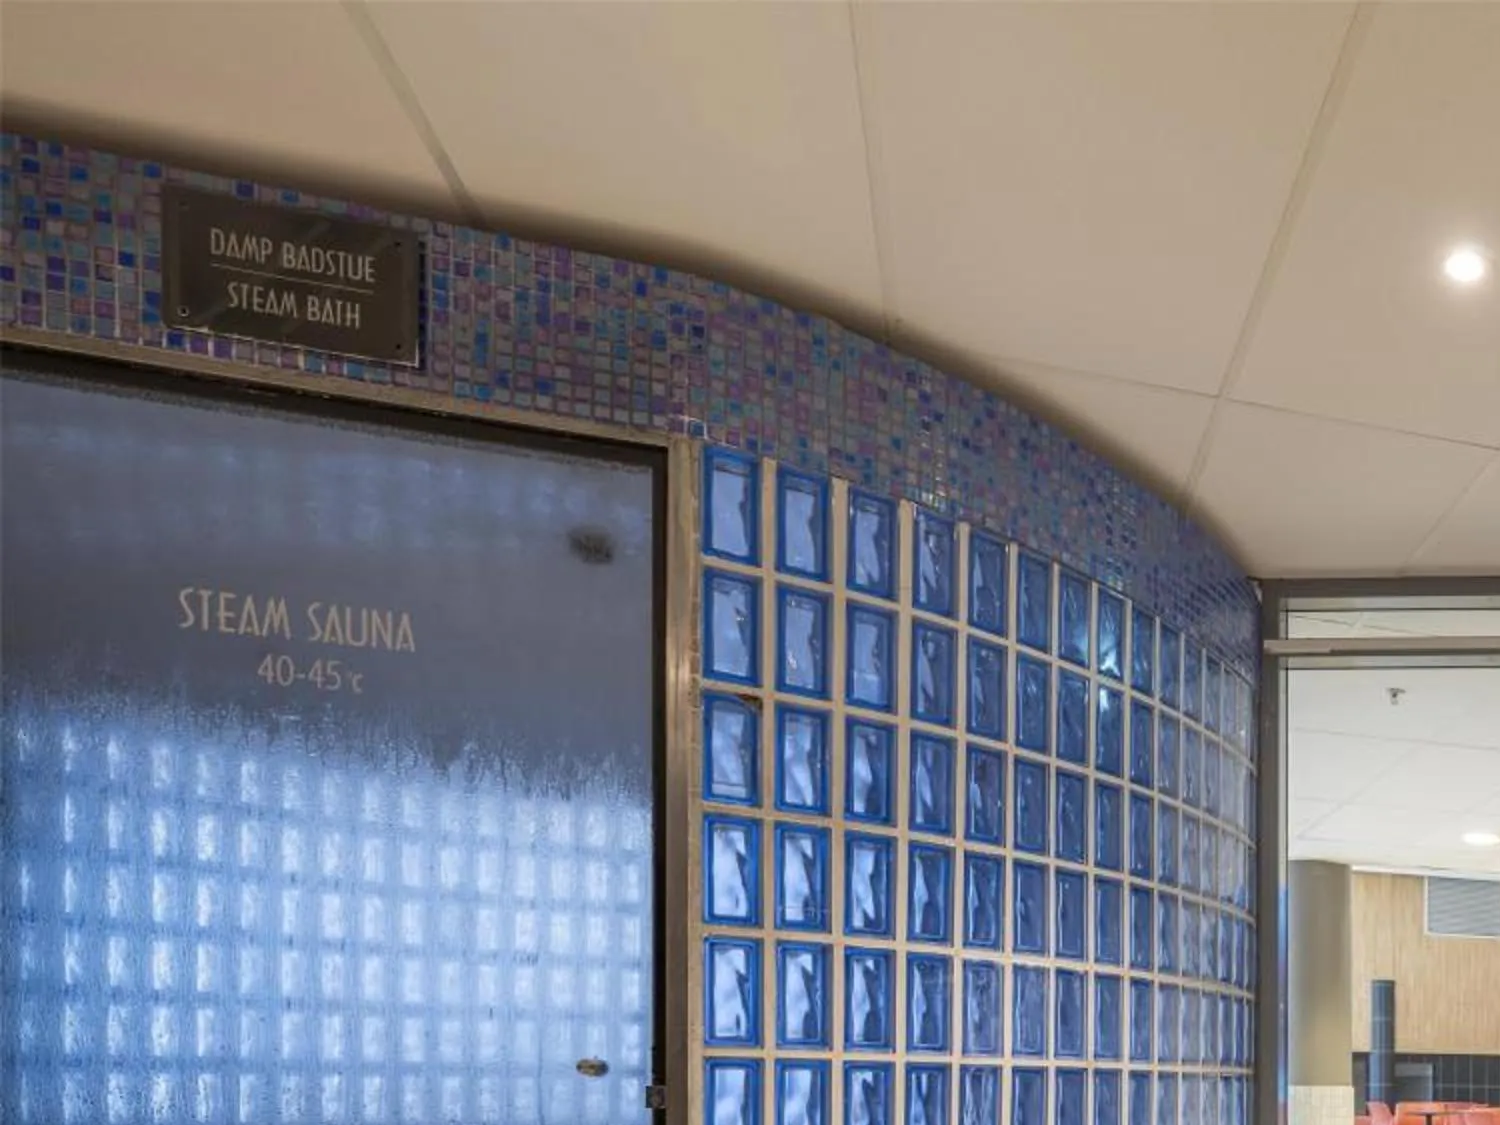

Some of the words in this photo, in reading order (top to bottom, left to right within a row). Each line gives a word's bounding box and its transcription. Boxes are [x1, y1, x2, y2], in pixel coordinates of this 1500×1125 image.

[210, 228, 273, 264] DAMP
[282, 242, 376, 282] BADSTUE
[227, 282, 298, 318] STEAM
[307, 296, 361, 329] BATH
[178, 587, 291, 640] STEAM
[306, 602, 415, 652] SAUNA
